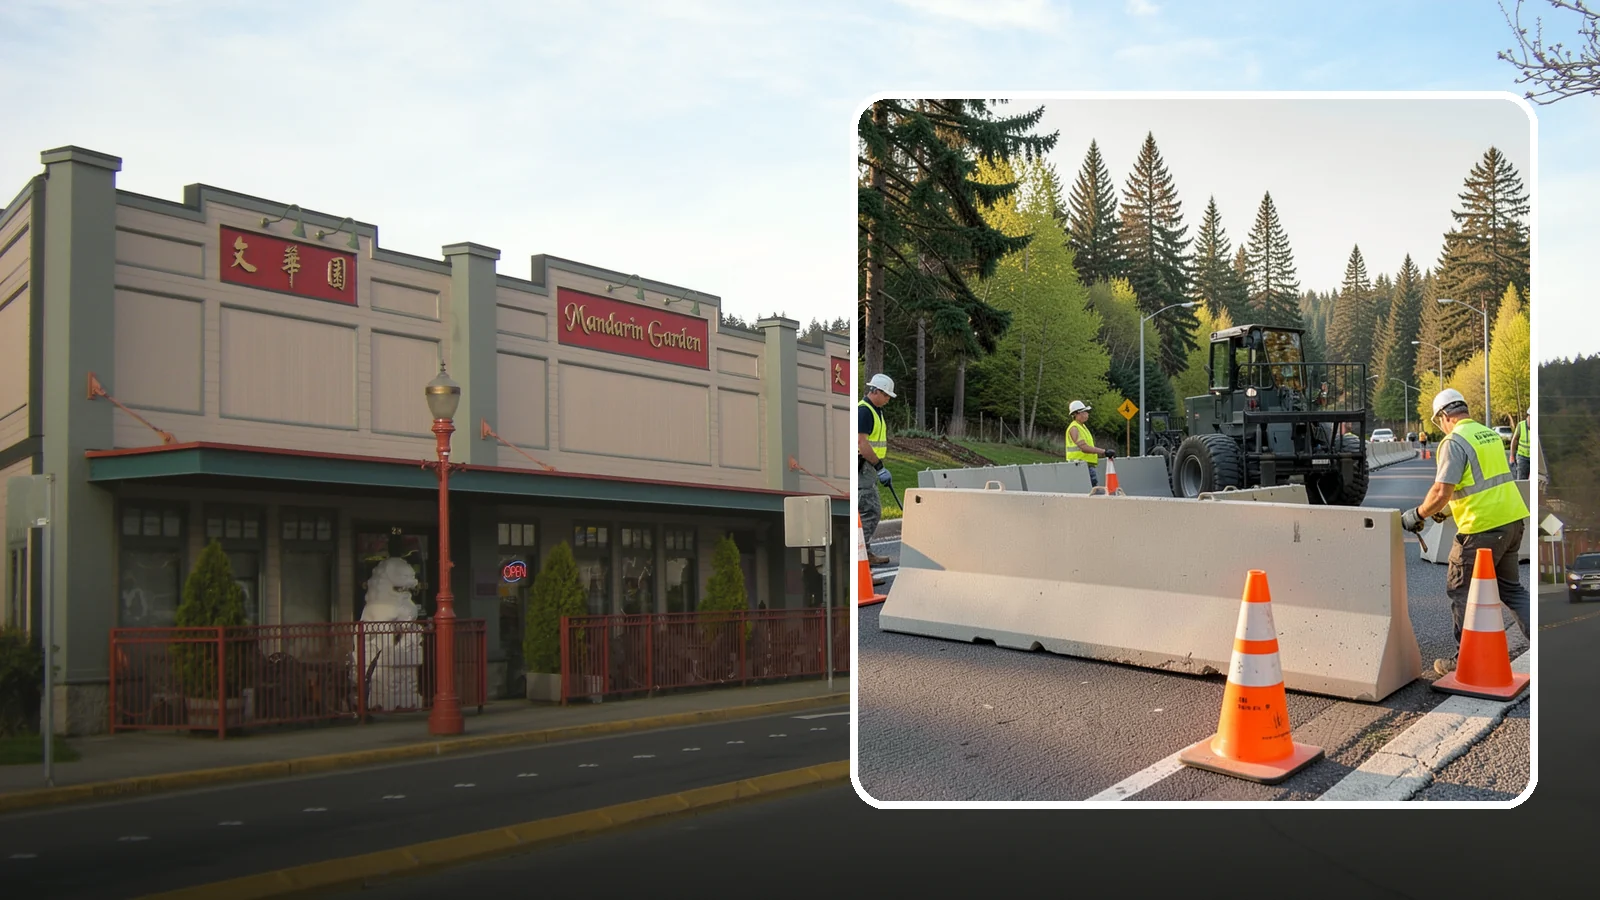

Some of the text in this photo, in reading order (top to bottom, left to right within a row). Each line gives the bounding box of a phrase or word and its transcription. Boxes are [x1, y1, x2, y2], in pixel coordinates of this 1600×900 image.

[230, 235, 347, 291] 文華園
[564, 302, 702, 352] Mandarin Garden
[503, 565, 527, 578] OPEN
